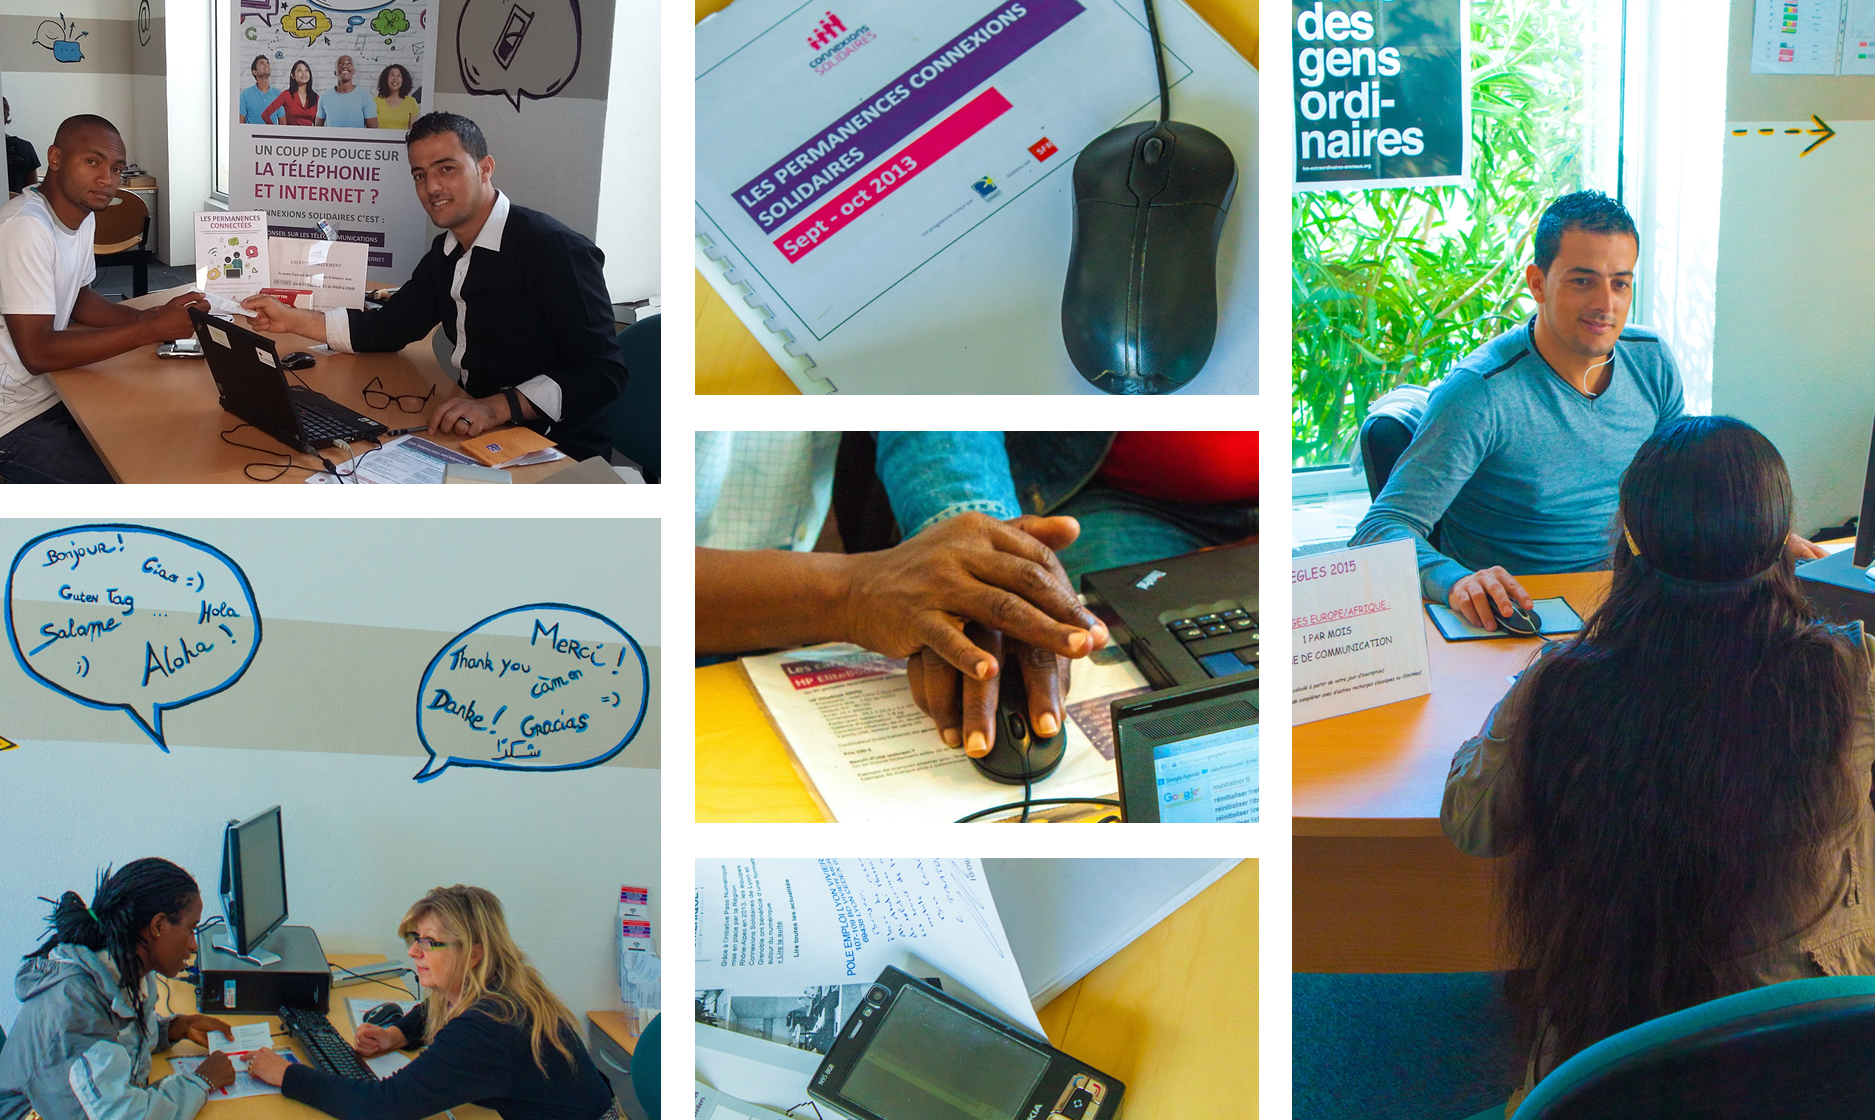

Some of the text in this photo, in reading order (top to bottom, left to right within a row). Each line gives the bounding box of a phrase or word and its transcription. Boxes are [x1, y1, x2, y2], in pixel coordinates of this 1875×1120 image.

[1297, 2, 1375, 42] des
[809, 24, 870, 68] connexions
[815, 30, 877, 76] SOLIDAIRES
[1298, 46, 1401, 88] gens
[740, 3, 1027, 208] LES PERMANENCES CONNEXIONS
[1300, 81, 1395, 121] ordi-
[255, 145, 399, 161] UN COUP DE POUCE SUR
[1301, 120, 1425, 160] naires
[255, 160, 381, 182] LA TÉLÉPHONIE
[255, 183, 274, 198] ET
[279, 185, 365, 204] INTERNET
[758, 146, 865, 227] SOLIDAIRES
[253, 208, 306, 219] NNEXIONS
[308, 212, 355, 222] SOLIDAIRES
[783, 220, 829, 256] Sept
[840, 187, 872, 216] oct
[871, 155, 918, 194] 2013
[141, 556, 179, 583] Ciao
[1330, 560, 1357, 576] 2015
[106, 587, 134, 616] Tag
[198, 600, 241, 625] Hola
[1308, 631, 1326, 643] PAR
[1327, 626, 1353, 639] MOIS
[141, 637, 214, 687] Aloha
[449, 644, 531, 678] Thank you
[1301, 636, 1393, 663] DE COMMUNICATION
[787, 664, 812, 675] Les
[794, 677, 814, 687] HP
[1347, 675, 1357, 683] jour
[1163, 787, 1199, 803] Google
[721, 864, 729, 898] Numérique
[785, 879, 795, 910] actualités
[834, 878, 848, 904] VIVIER
[835, 863, 869, 943] 69438 LYON CEDEX
[846, 905, 854, 919] BD
[742, 919, 748, 927] en
[818, 858, 856, 976] POLE EMPLOI LYON VIVIER
[732, 943, 738, 952] en
[748, 931, 756, 966] Connexions
[849, 920, 862, 951] 107-109
[757, 939, 765, 966] Grenoble
[818, 1063, 835, 1086] N95 8GB
